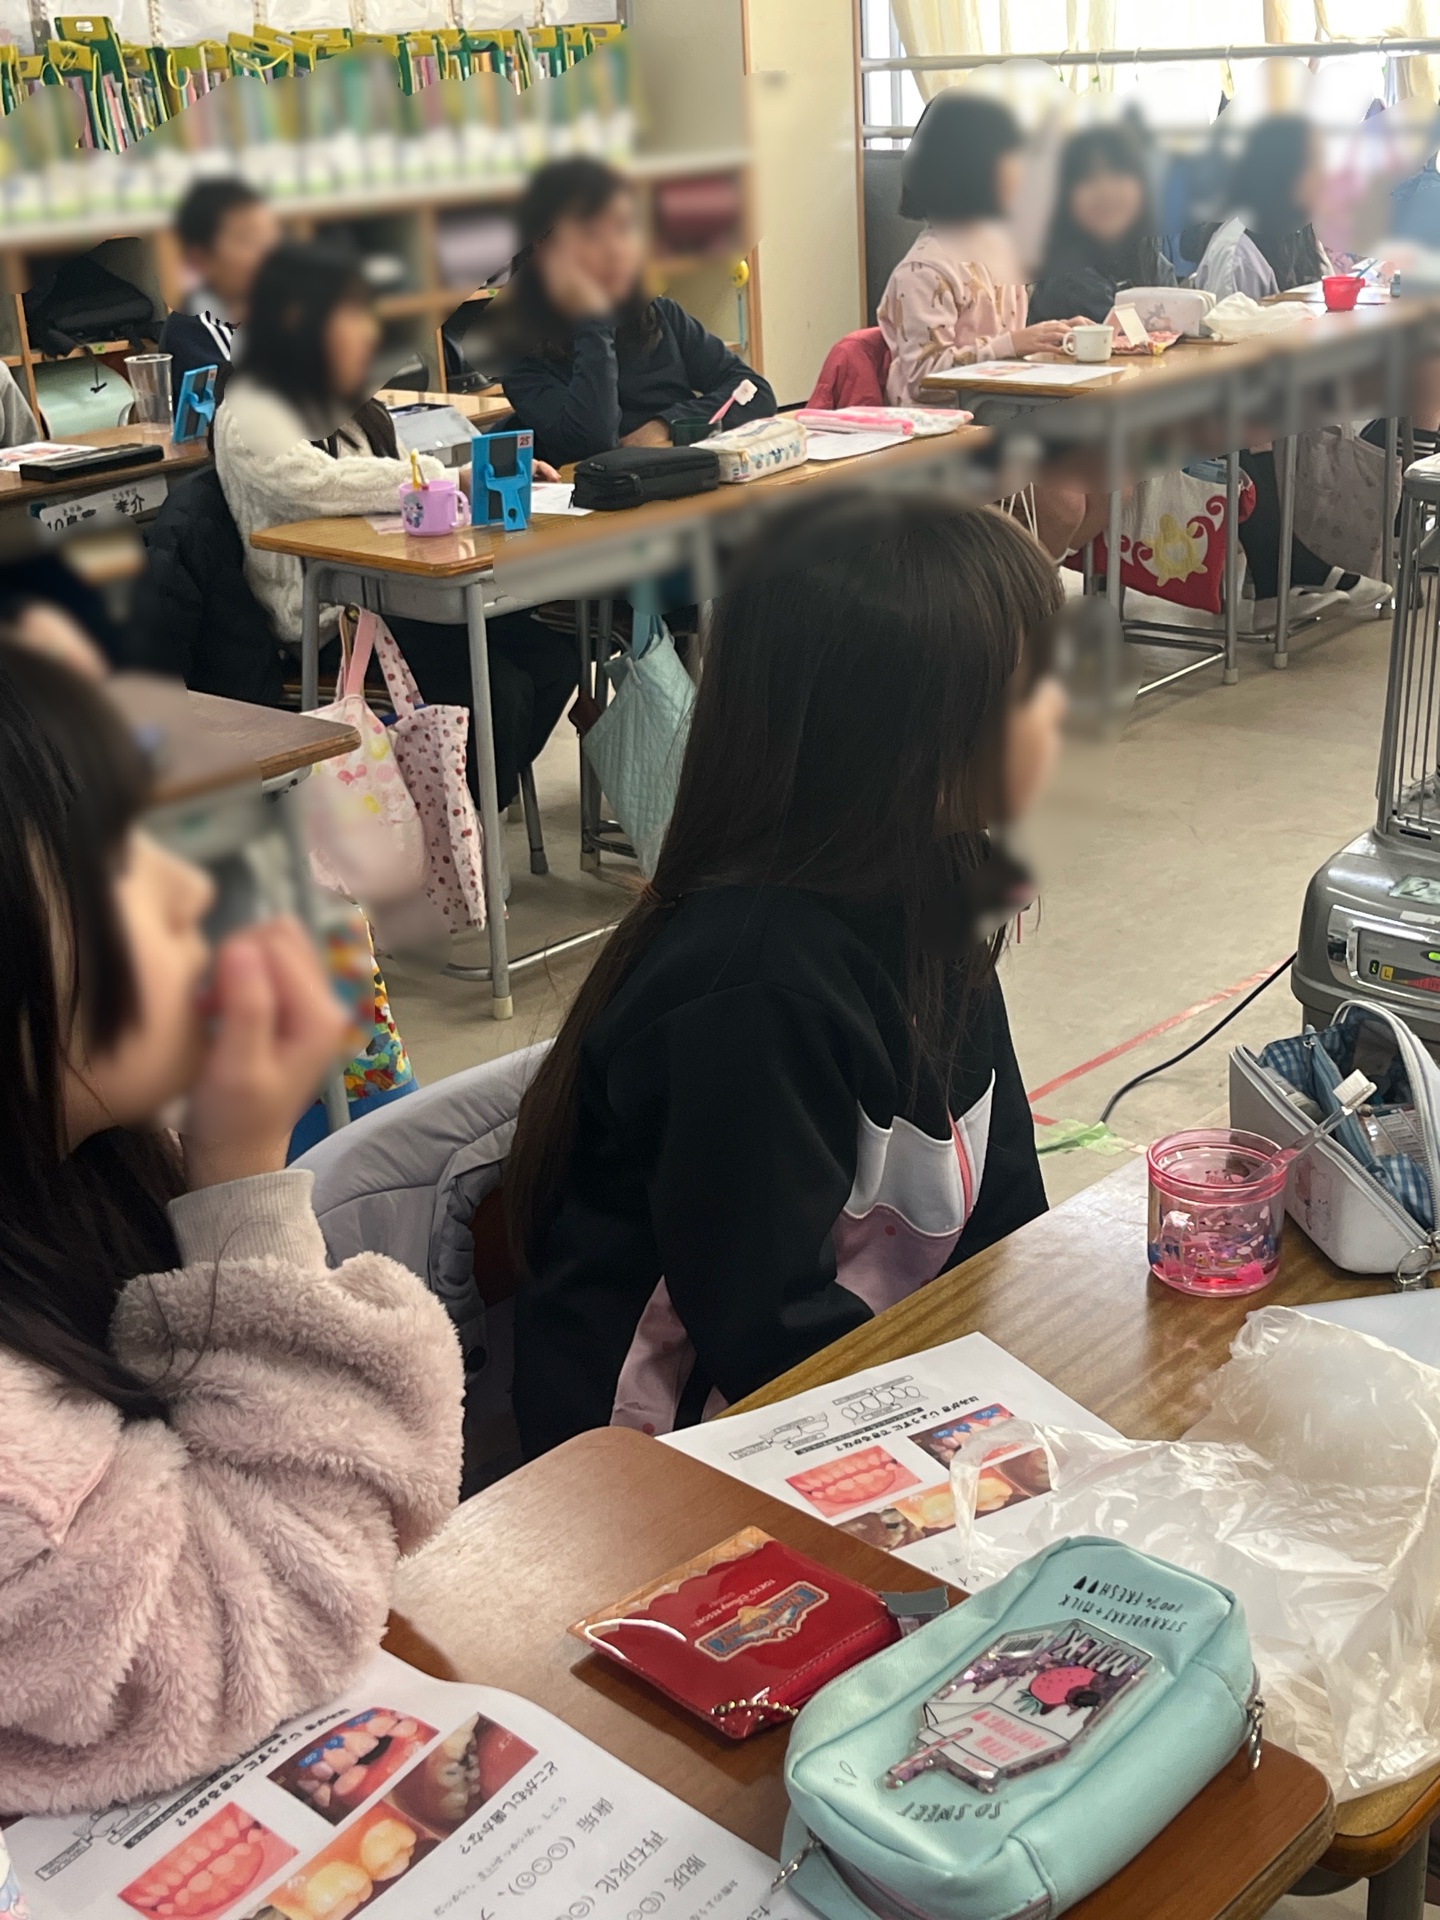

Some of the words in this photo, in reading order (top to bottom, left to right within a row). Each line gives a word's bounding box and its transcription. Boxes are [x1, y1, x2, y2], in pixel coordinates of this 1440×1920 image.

[519, 436, 531, 446] 25
[1098, 1582, 1143, 1605] FRESH
[1055, 1628, 1140, 1677] MILK
[595, 1829, 669, 1894] 再石灰化
[664, 1853, 706, 1892] 脱灰
